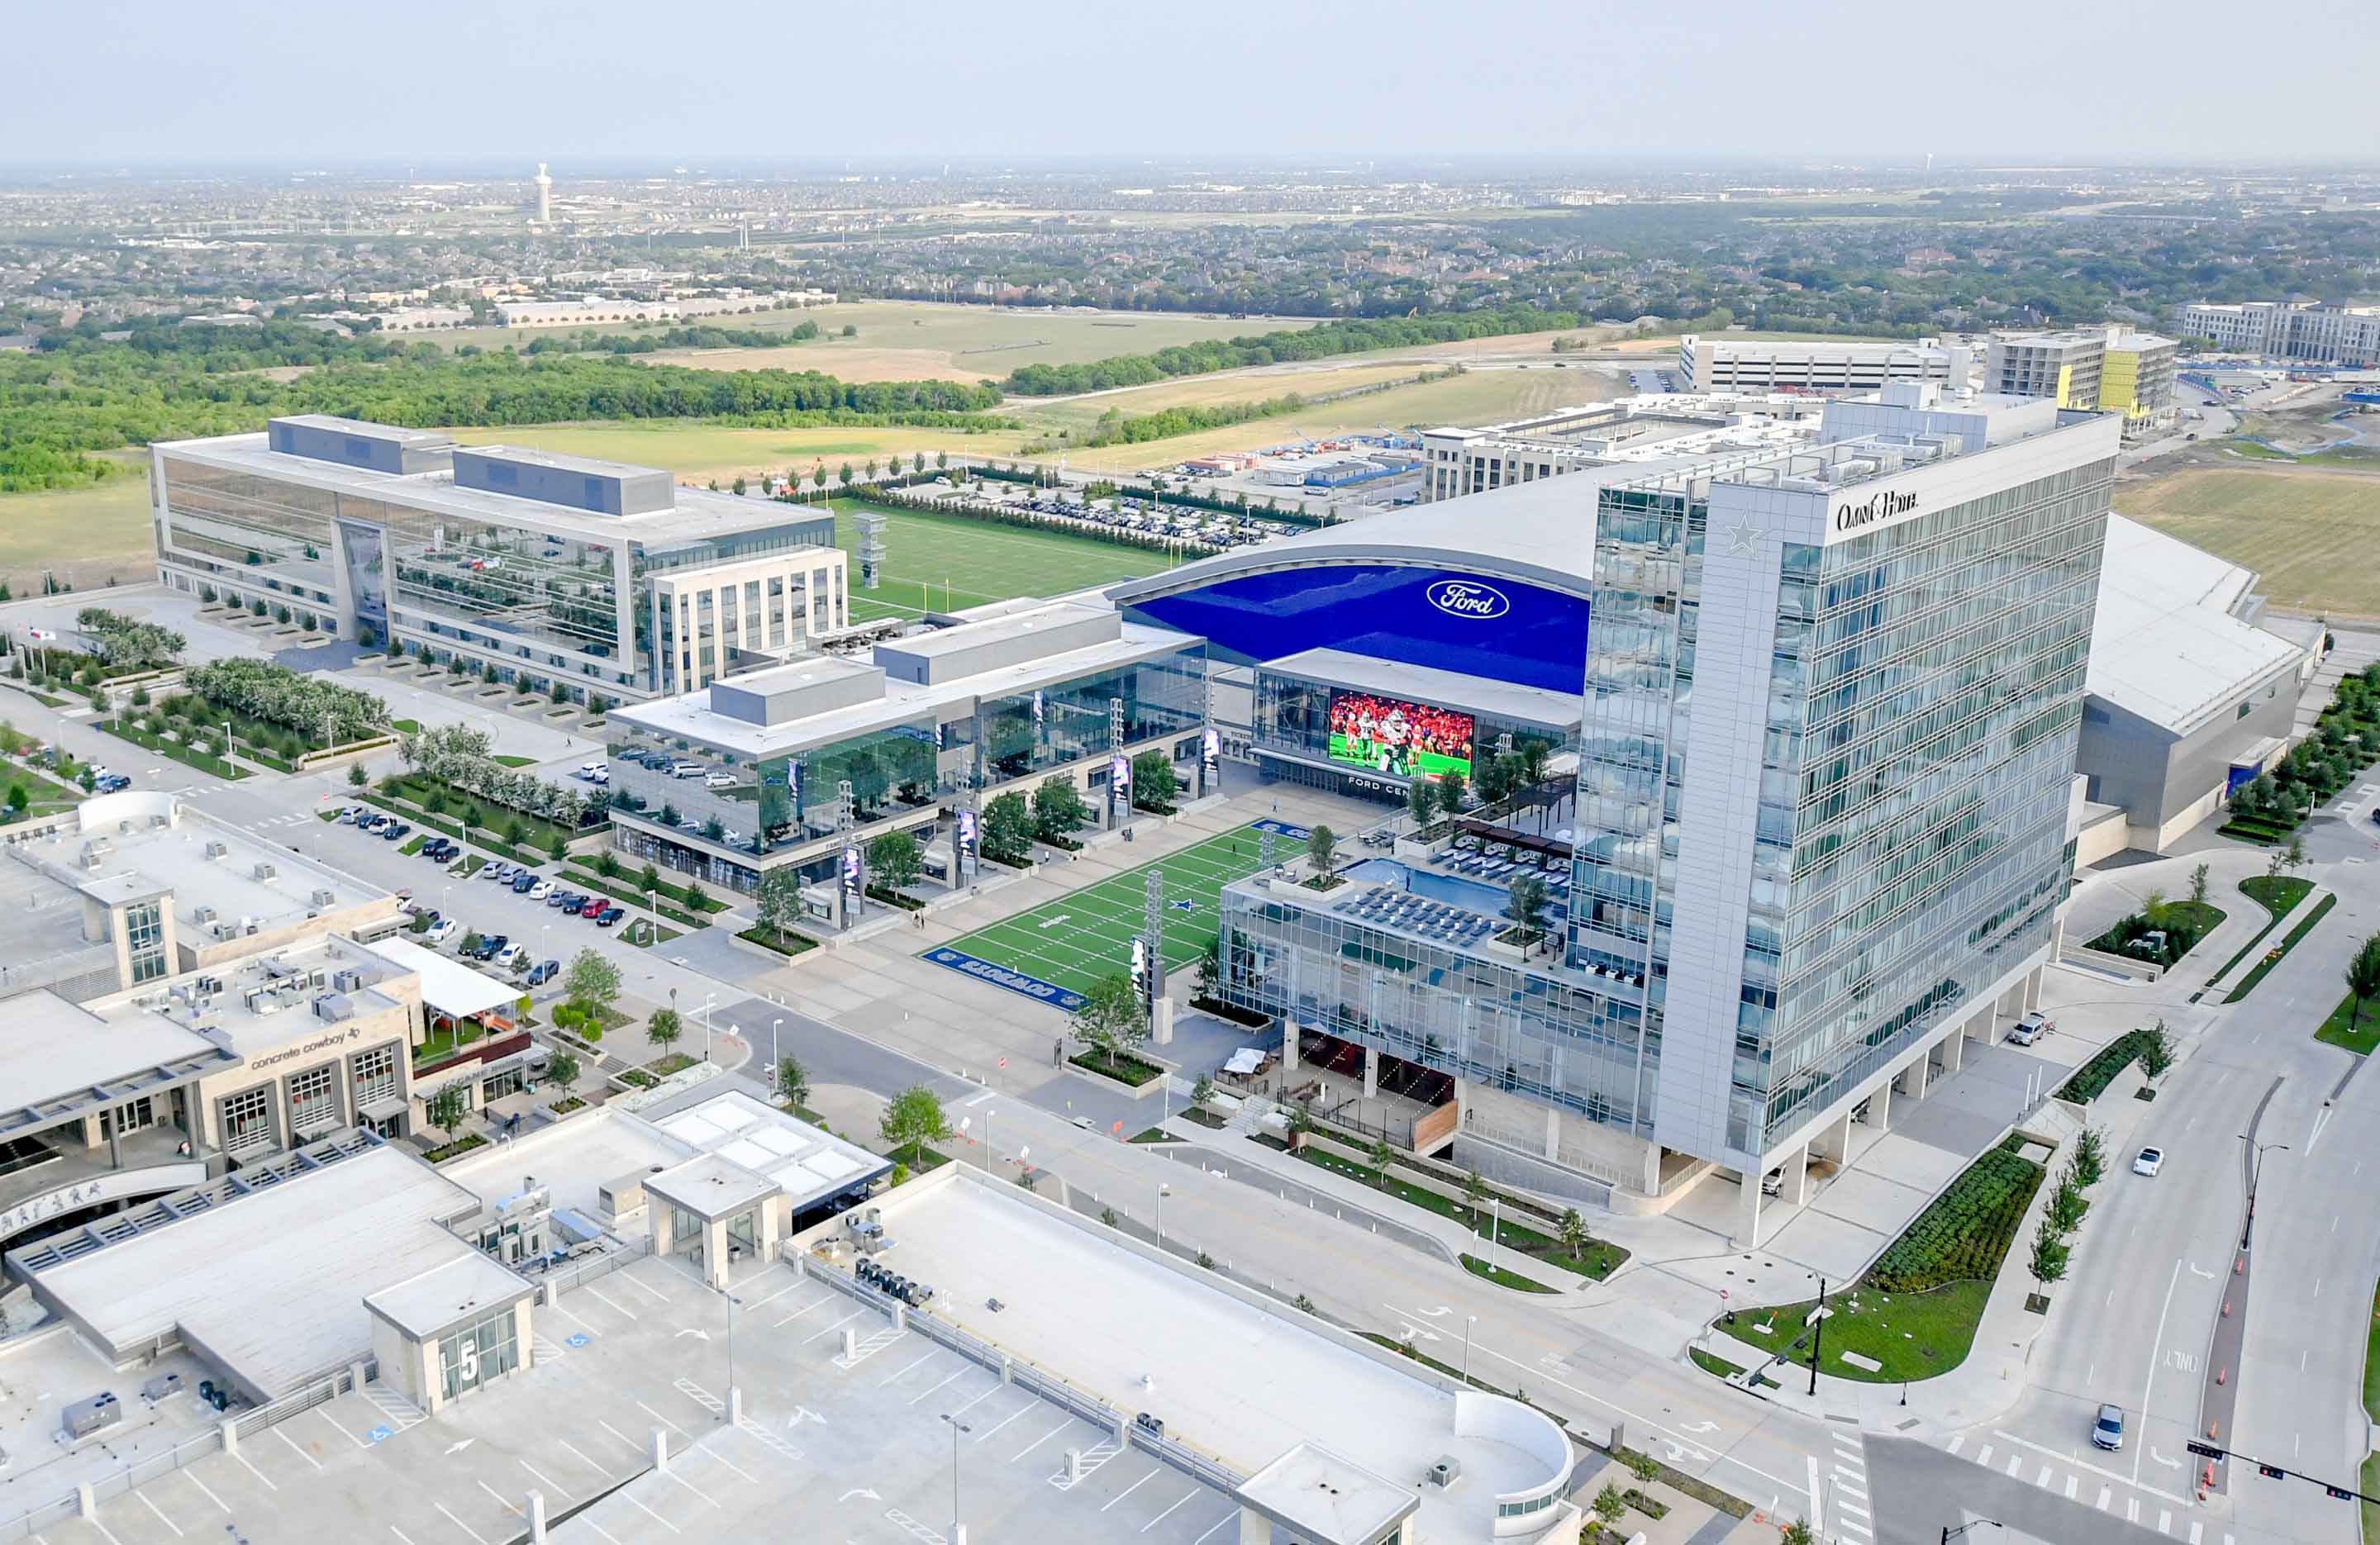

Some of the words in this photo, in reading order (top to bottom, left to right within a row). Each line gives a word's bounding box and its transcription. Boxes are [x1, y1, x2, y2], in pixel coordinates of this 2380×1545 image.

[1440, 584, 1494, 614] Ford
[1348, 777, 1380, 790] FORD
[959, 960, 1056, 997] COWBOYS
[251, 1047, 301, 1071] concrete
[303, 1033, 345, 1053] cowboy
[461, 1344, 478, 1381] 5
[2163, 1348, 2198, 1372] ONLY
